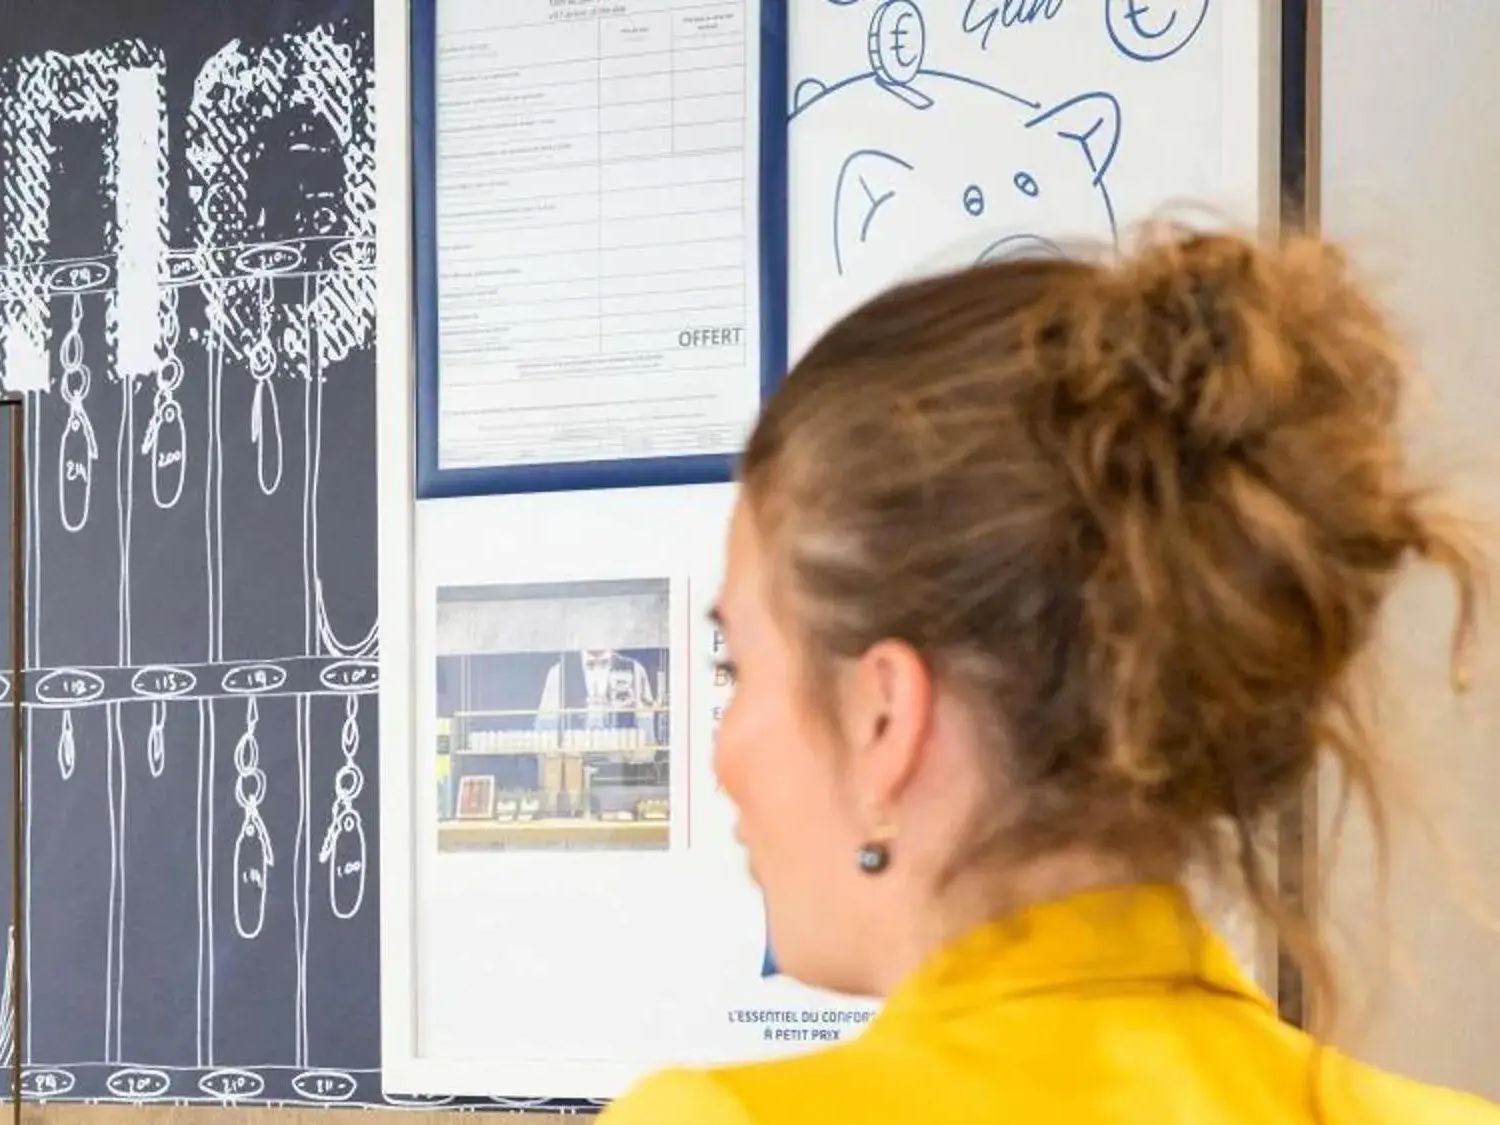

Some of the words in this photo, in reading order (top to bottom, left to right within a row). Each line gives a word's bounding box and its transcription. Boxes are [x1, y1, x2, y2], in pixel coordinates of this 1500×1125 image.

[678, 326, 743, 348] OFFERT
[158, 450, 183, 467] 200
[337, 860, 361, 879] 100
[728, 1009, 798, 1024] L'ESSENTIEL
[801, 1010, 819, 1024] DU
[776, 1028, 808, 1041] PETIT
[811, 1028, 841, 1041] PRIX
